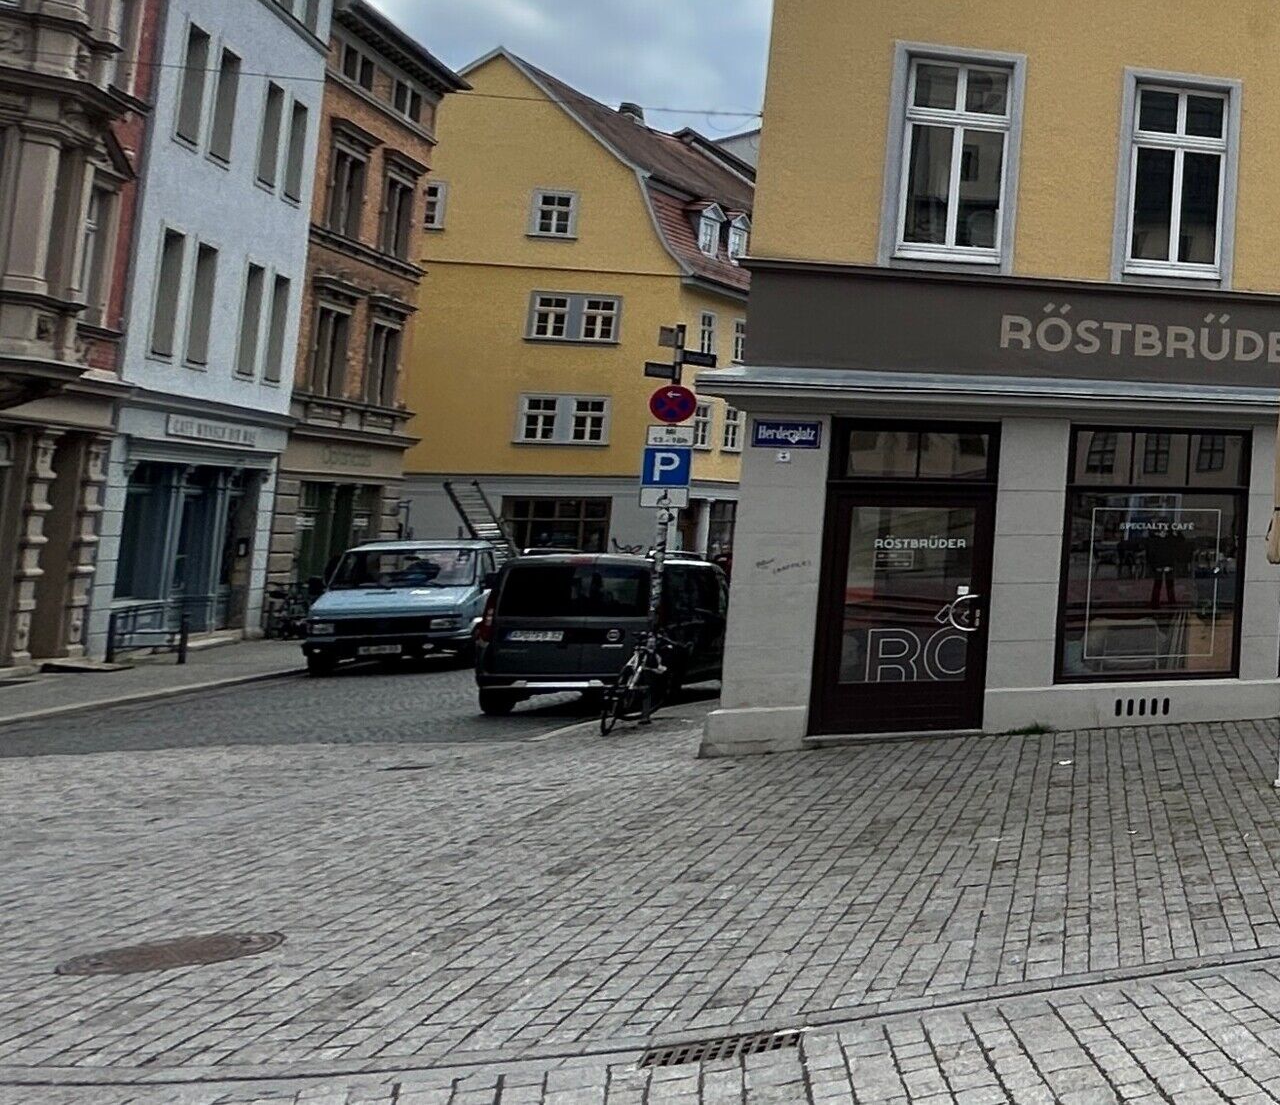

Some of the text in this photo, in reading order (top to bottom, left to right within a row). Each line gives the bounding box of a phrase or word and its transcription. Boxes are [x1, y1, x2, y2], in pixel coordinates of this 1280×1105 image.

[653, 452, 680, 481] P
[1120, 522, 1169, 531] SPECIALTY
[874, 535, 966, 549] RÖSTBRÜDER
